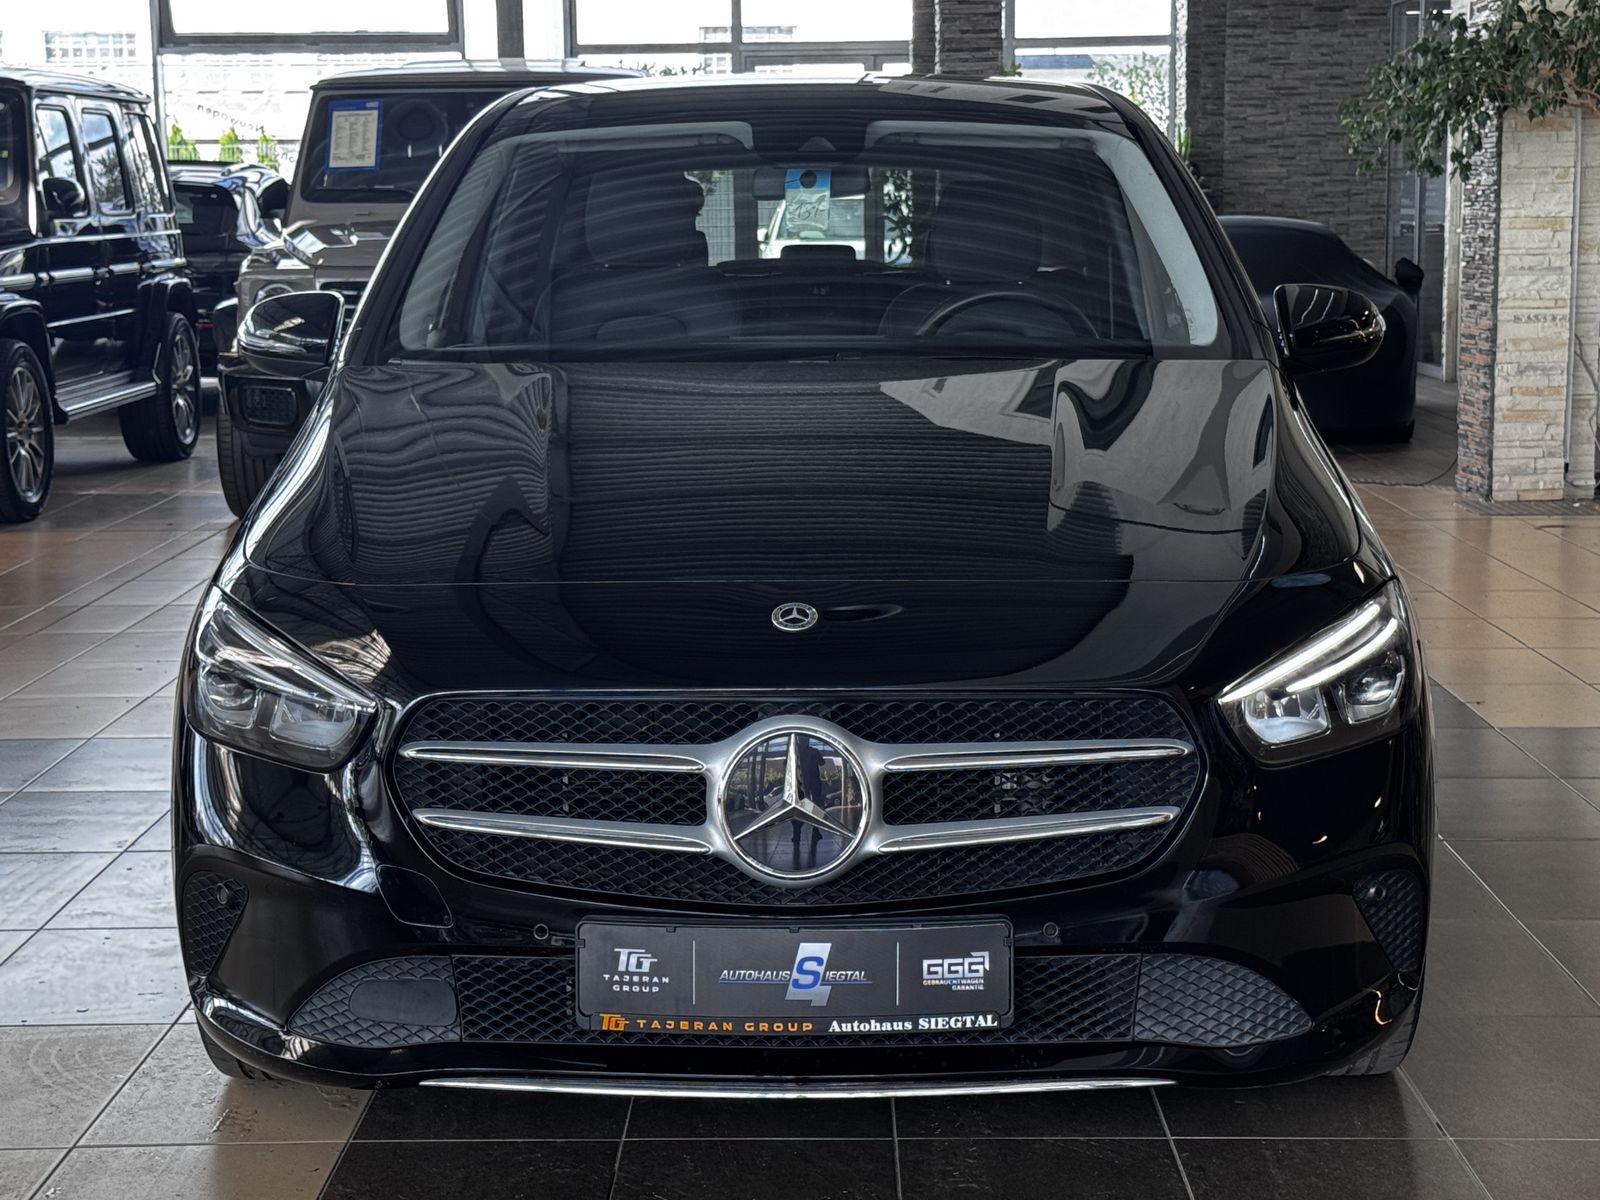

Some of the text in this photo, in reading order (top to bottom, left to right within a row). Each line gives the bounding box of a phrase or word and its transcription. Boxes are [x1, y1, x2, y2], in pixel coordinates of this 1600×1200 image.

[613, 948, 658, 972] TG
[922, 956, 985, 979] GGG
[602, 974, 669, 984] TAJERAN
[719, 970, 791, 981] AUTOHAUS
[922, 978, 984, 986] GEBRAUCHTWAGEN
[612, 984, 660, 993] GROUP
[636, 1019, 733, 1031] TAJERAN
[744, 1022, 813, 1032] GROUP
[827, 1020, 913, 1033] Autohaus
[918, 1014, 998, 1030] SIEGTAL
